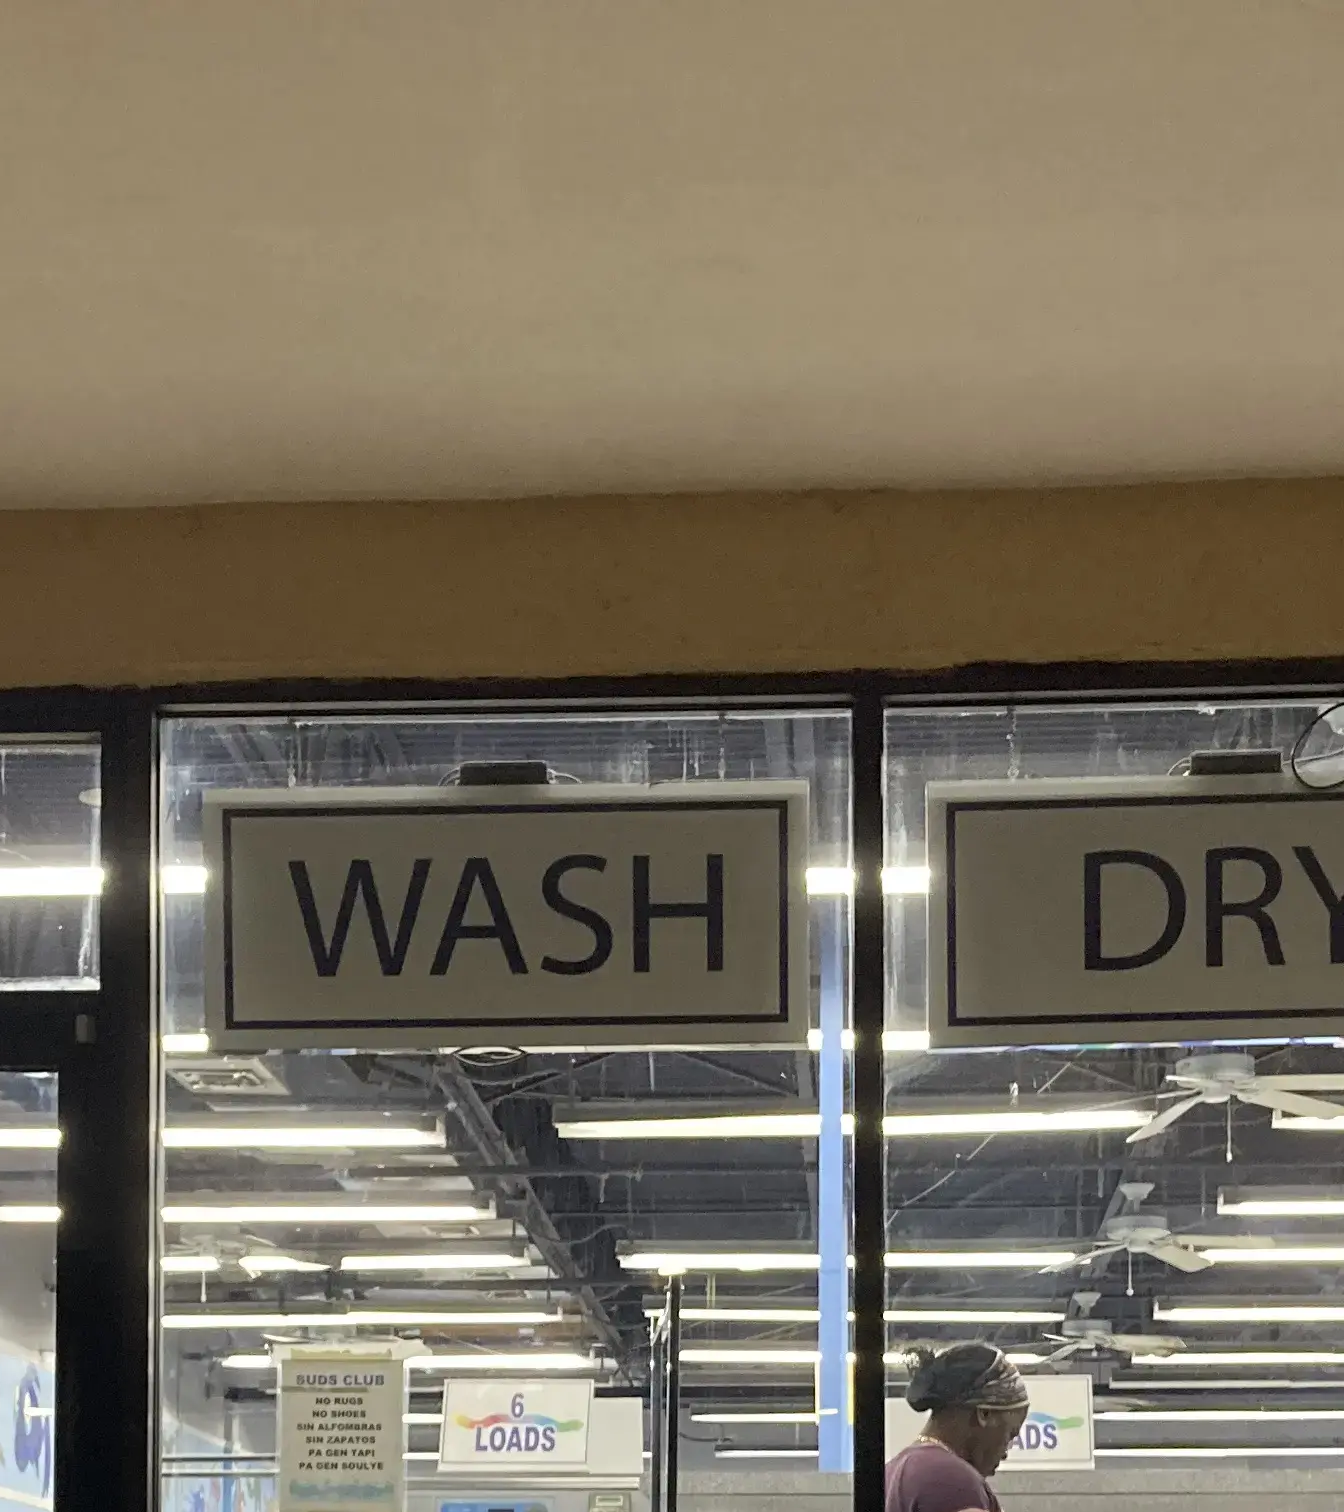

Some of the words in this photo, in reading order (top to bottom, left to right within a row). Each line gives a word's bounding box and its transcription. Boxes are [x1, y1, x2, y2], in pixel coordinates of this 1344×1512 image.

[288, 852, 724, 977] WASH
[296, 1374, 337, 1386] SUDS
[343, 1374, 385, 1386] CLUB
[316, 1397, 331, 1405] NO
[334, 1397, 363, 1405] RUGS
[511, 1392, 524, 1418] 6
[312, 1410, 327, 1418] NO
[331, 1410, 366, 1418] SHOES
[297, 1423, 314, 1431] SIN
[318, 1423, 382, 1431] ALFOMBRAS
[306, 1436, 323, 1444] SIN
[327, 1436, 376, 1444] ZAPATOS
[475, 1426, 555, 1452] LOADS
[308, 1449, 322, 1457] PA
[326, 1449, 347, 1457] GEN
[352, 1449, 375, 1457] TAPI
[299, 1462, 313, 1470] PA
